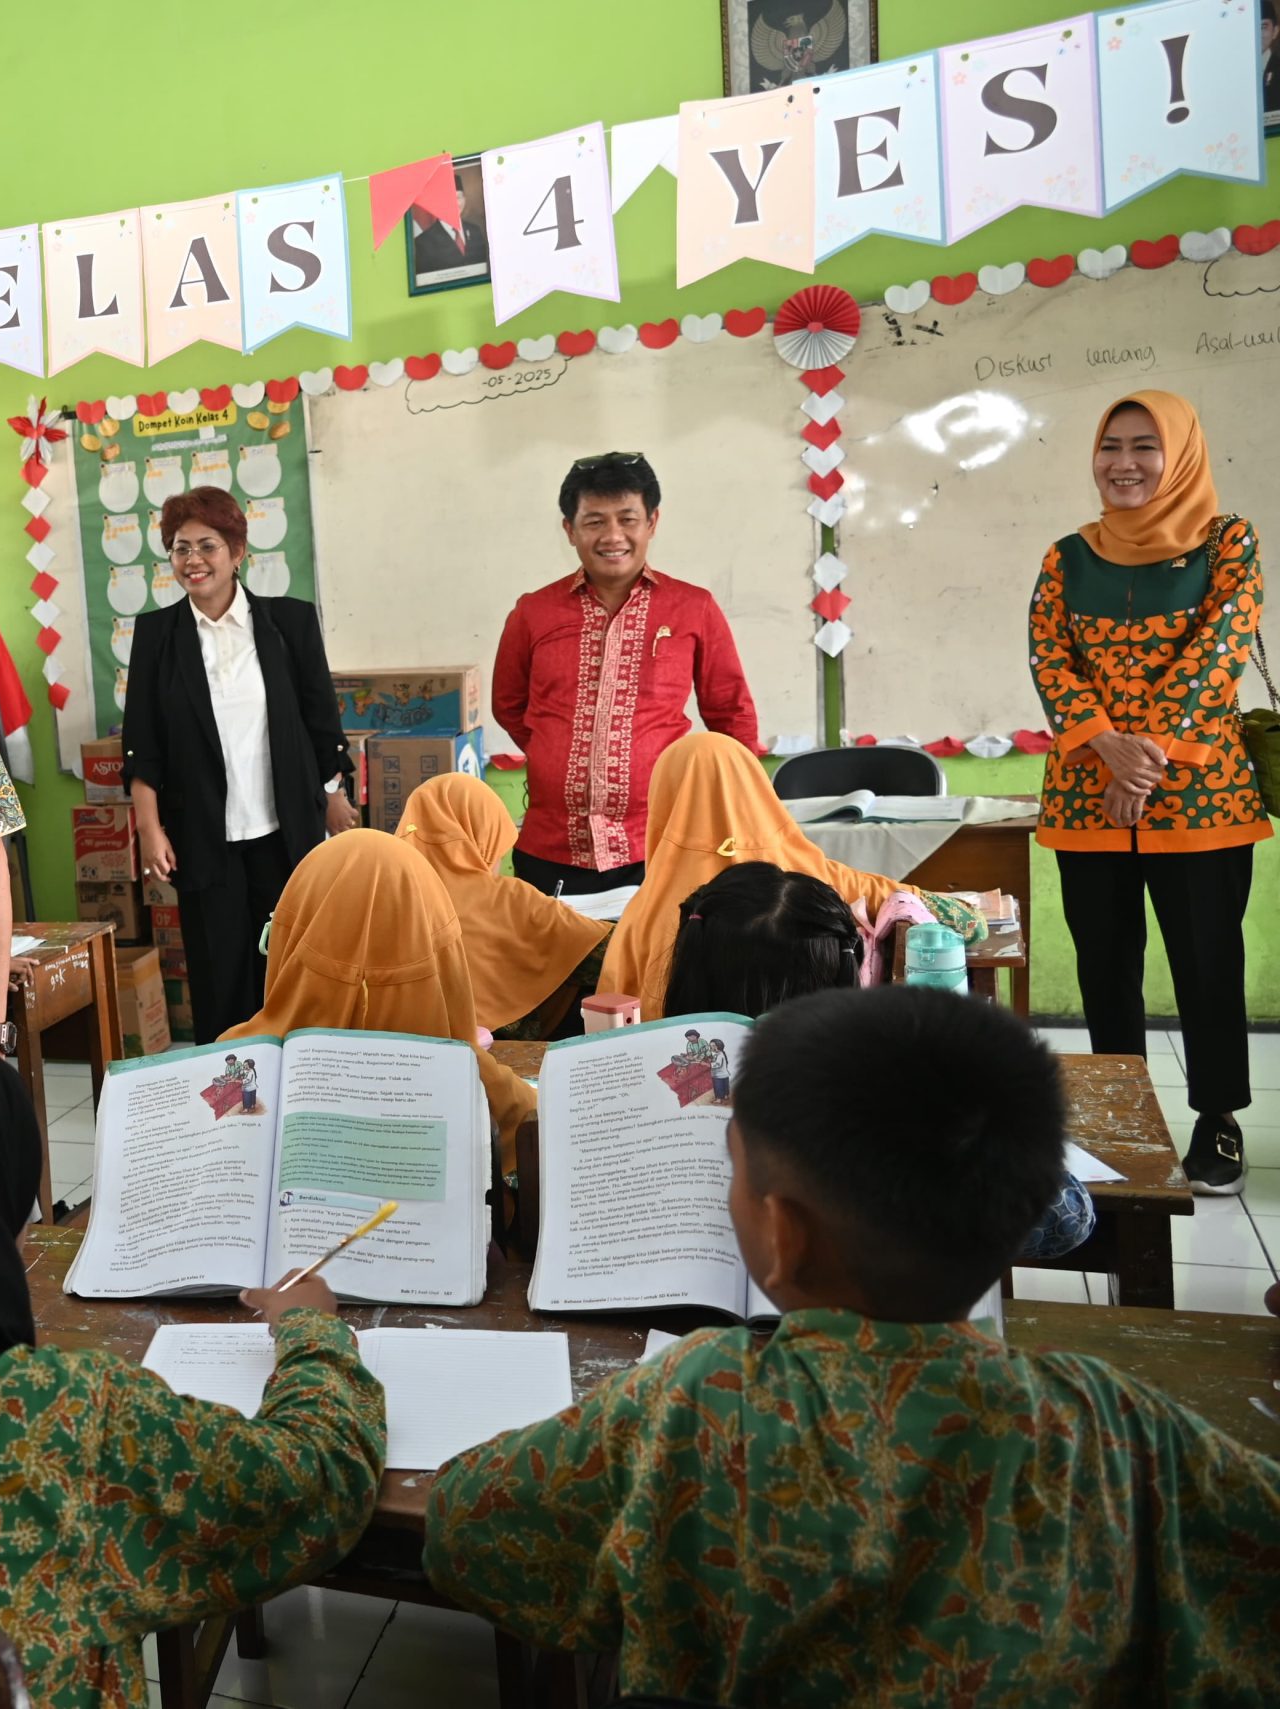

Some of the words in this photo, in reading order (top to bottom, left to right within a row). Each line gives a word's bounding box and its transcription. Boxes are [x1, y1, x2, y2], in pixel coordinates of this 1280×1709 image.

[523, 176, 584, 250] 4
[710, 35, 1191, 225] YES!
[138, 417, 172, 433] Dompet
[174, 413, 195, 426] Koin
[196, 411, 219, 425] Kelas
[221, 409, 229, 421] 4
[92, 761, 124, 775] ASTO
